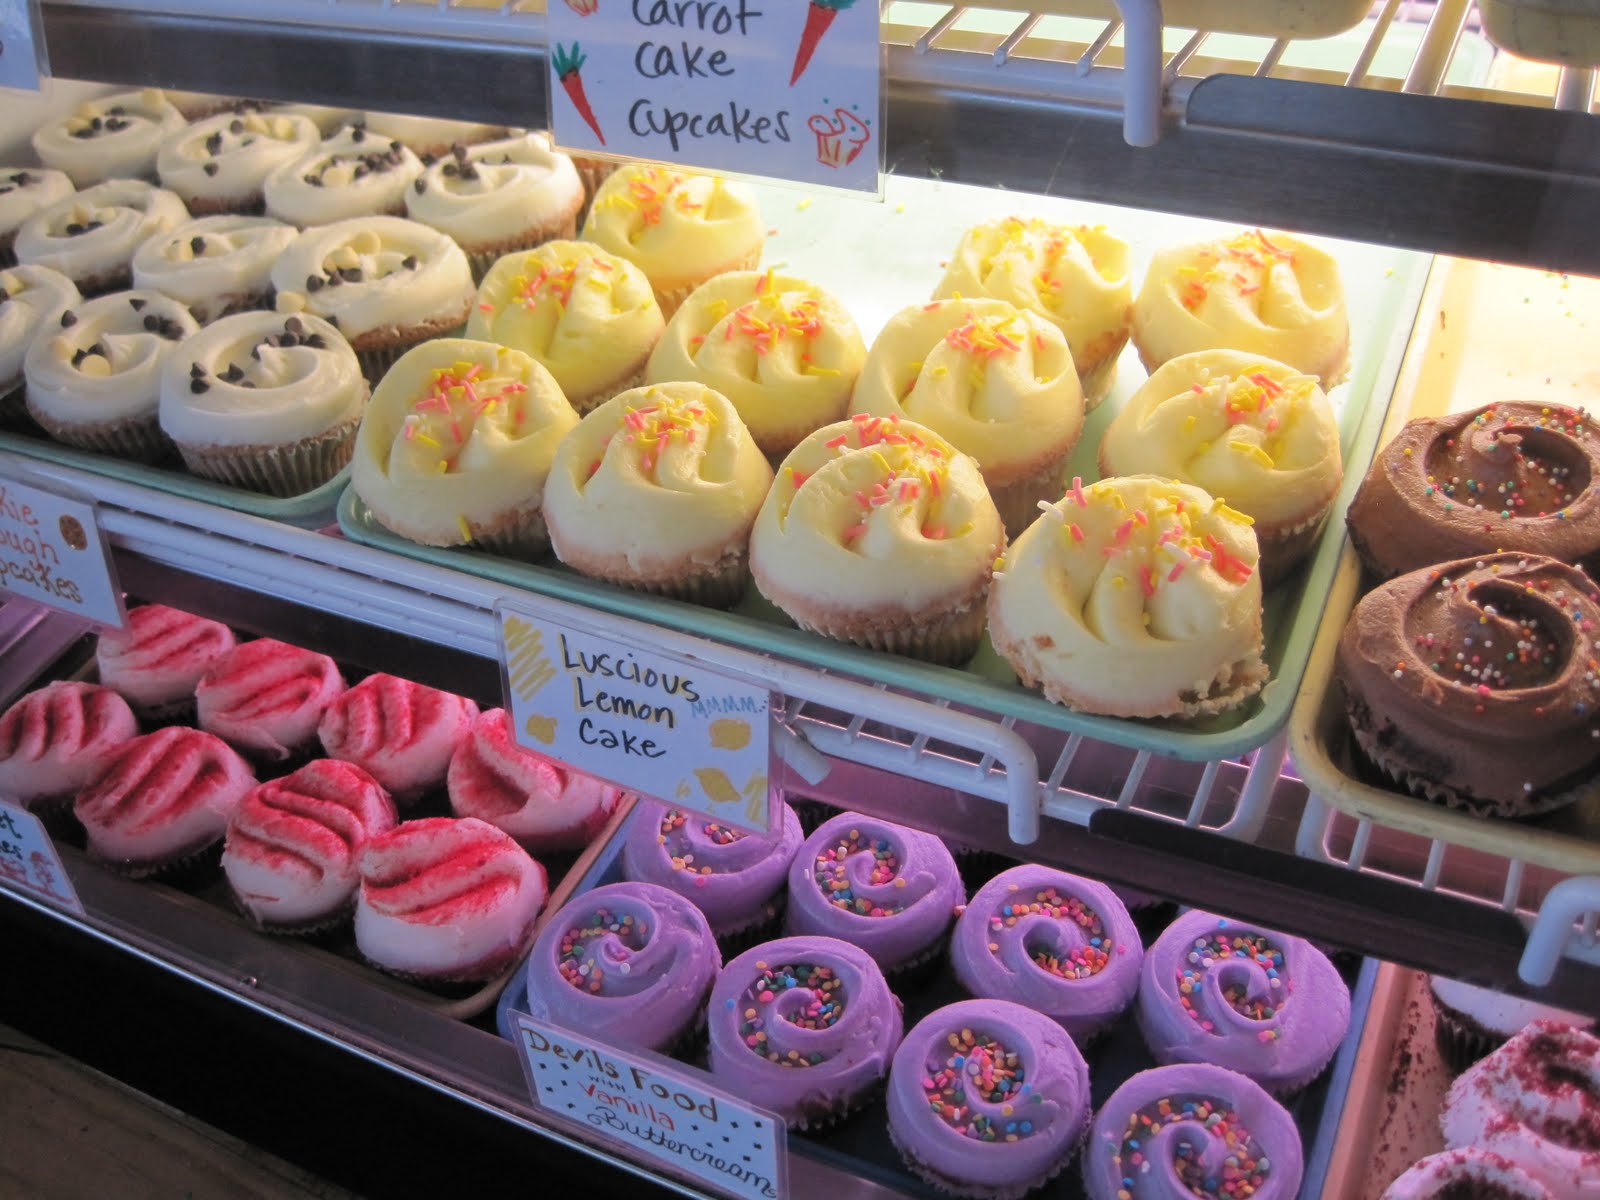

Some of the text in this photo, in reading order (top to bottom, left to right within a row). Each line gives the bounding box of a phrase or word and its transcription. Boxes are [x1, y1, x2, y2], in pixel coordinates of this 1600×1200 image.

[632, 0, 763, 36] Carrot
[628, 98, 791, 152] Cupcakes
[560, 633, 700, 702] Luscious
[576, 676, 674, 729] Lemon
[578, 717, 667, 758] Cake
[520, 1027, 719, 1122] Devils Food
[576, 1080, 675, 1132] Vanilla
[586, 1105, 778, 1198] Buttercream
